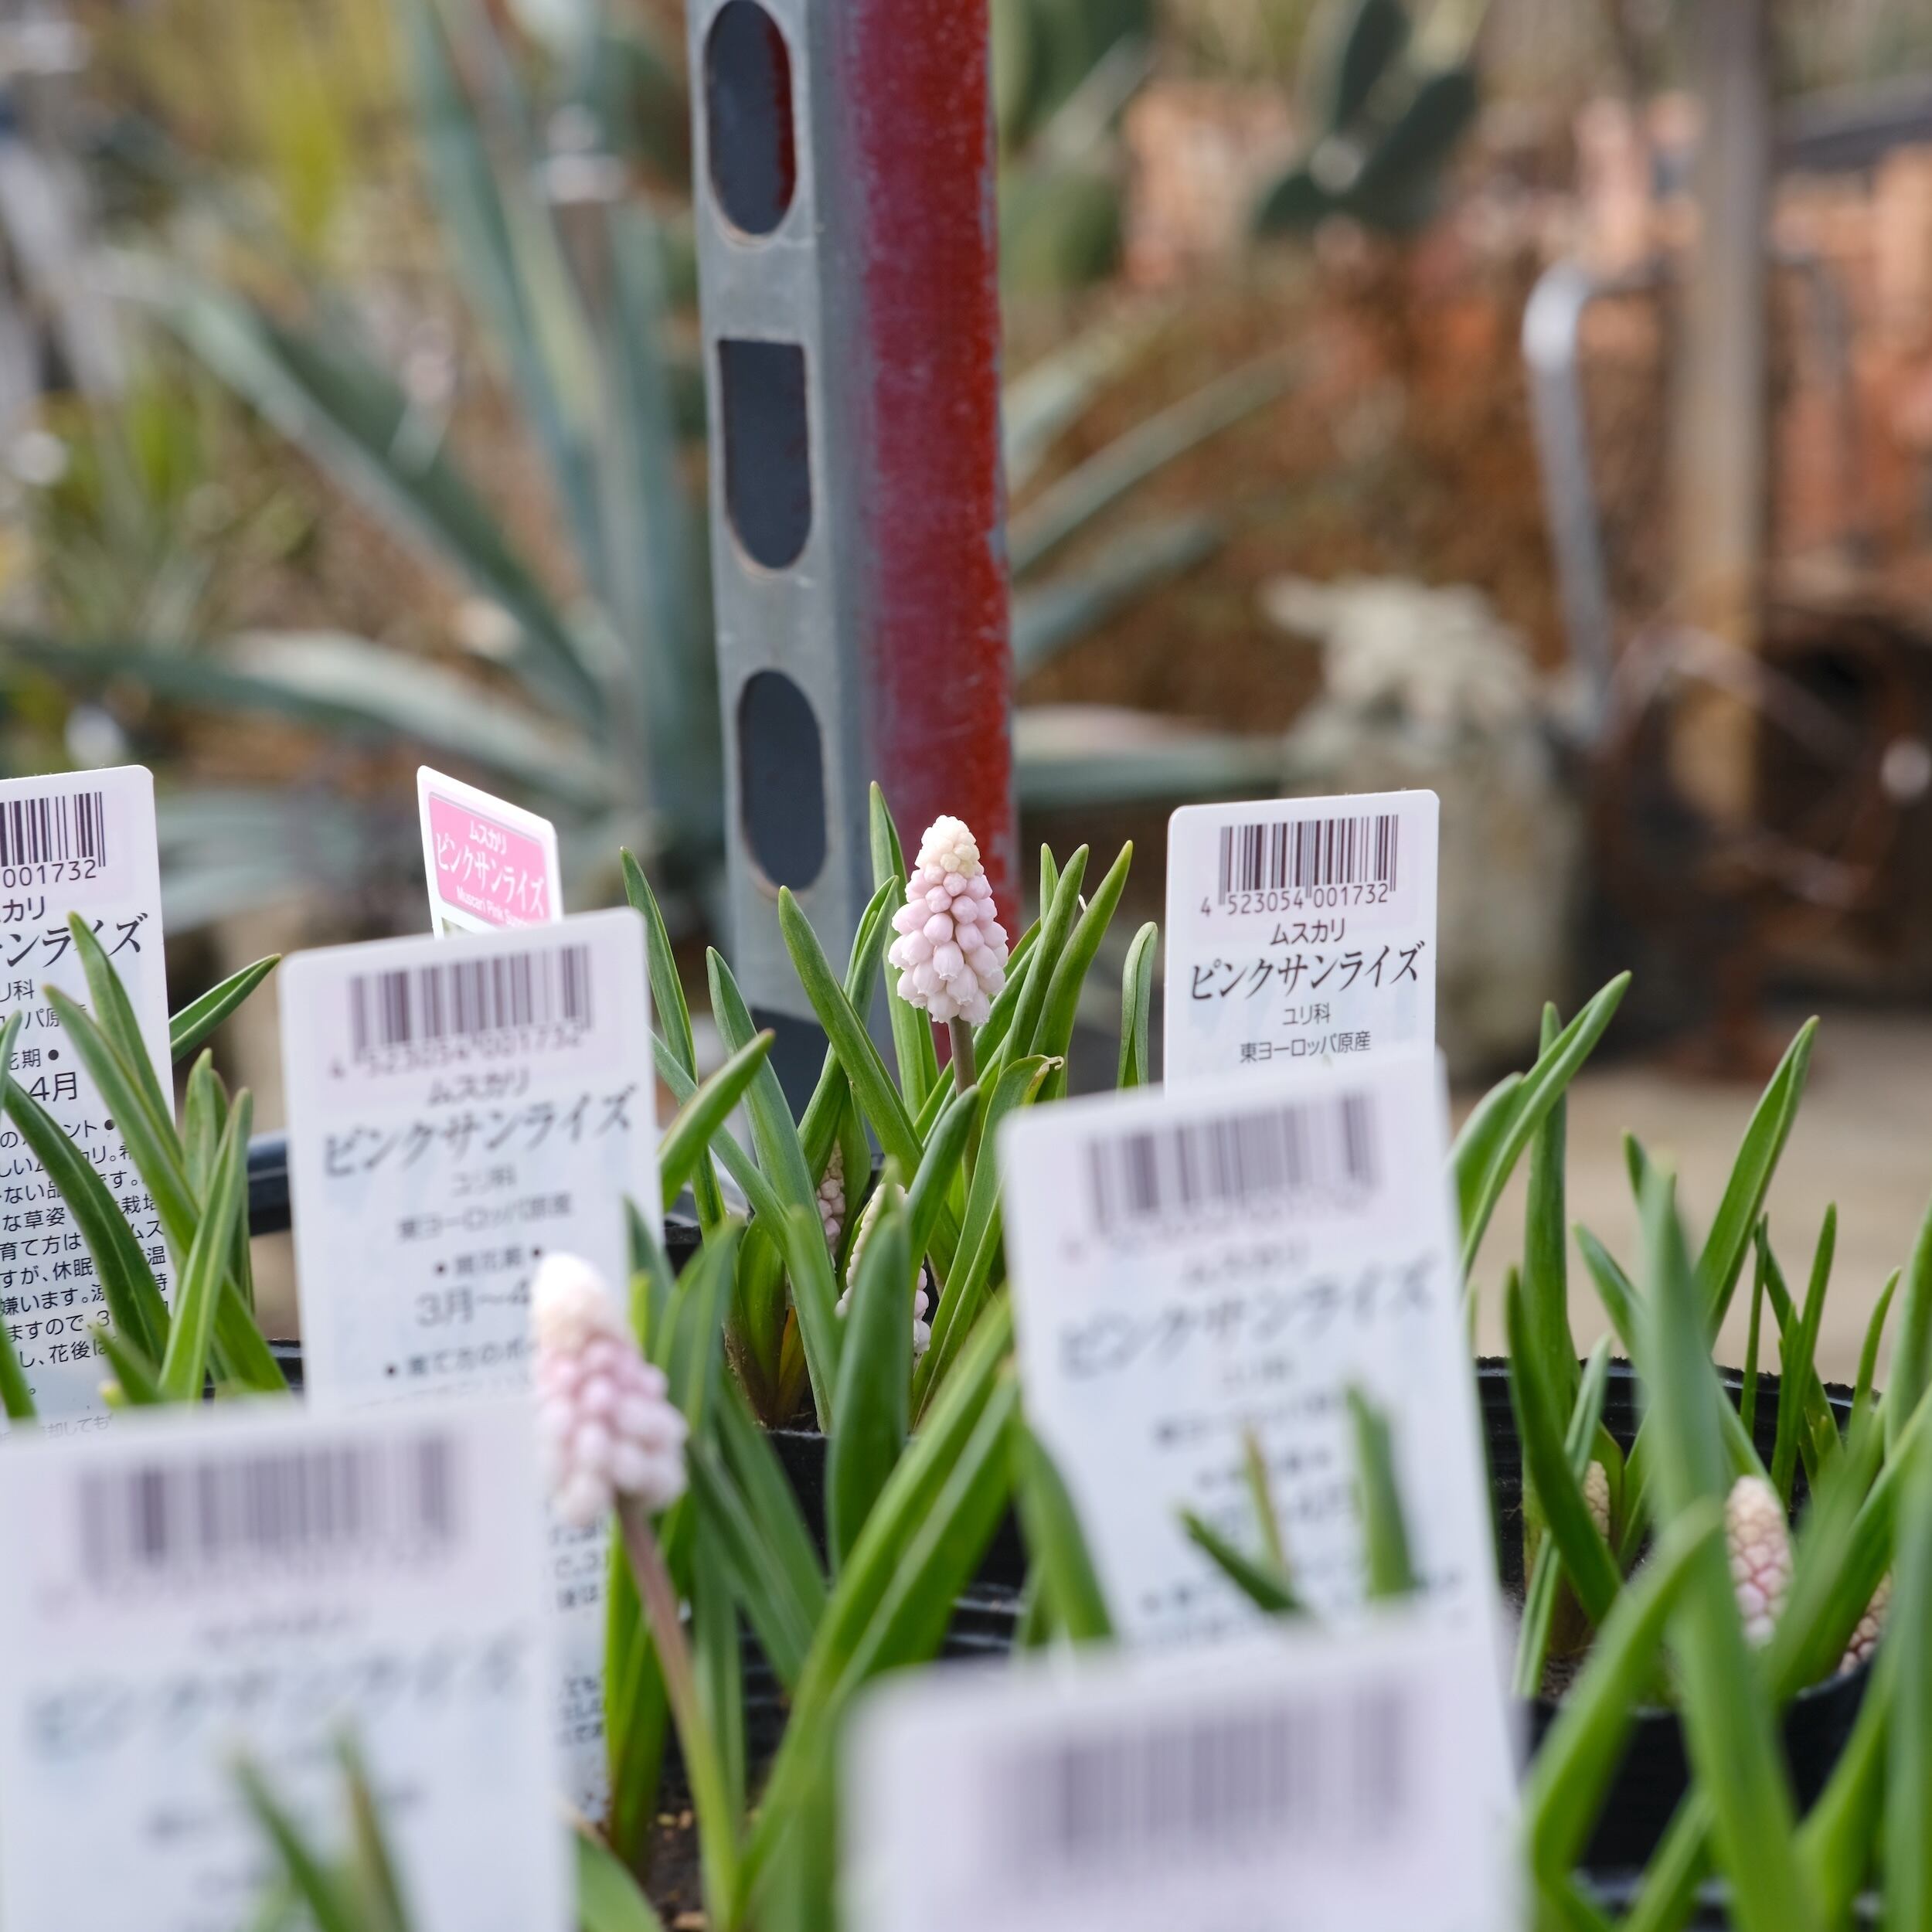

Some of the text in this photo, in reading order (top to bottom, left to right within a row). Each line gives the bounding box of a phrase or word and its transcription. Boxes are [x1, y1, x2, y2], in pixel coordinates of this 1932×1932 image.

[469, 820, 507, 855] ムスカリ
[3, 859, 96, 888] 001732
[0, 896, 45, 923] カリ
[1200, 883, 1389, 917] 4 523054 001732
[0, 913, 148, 968] ンラズ
[1270, 918, 1346, 946] ムスカリ
[1191, 940, 1426, 1001] ピンクサンライズ
[1283, 1002, 1330, 1026] ユリ科
[1240, 1030, 1372, 1063] 東ヨーロッパ原産
[29, 1071, 77, 1101] 4月
